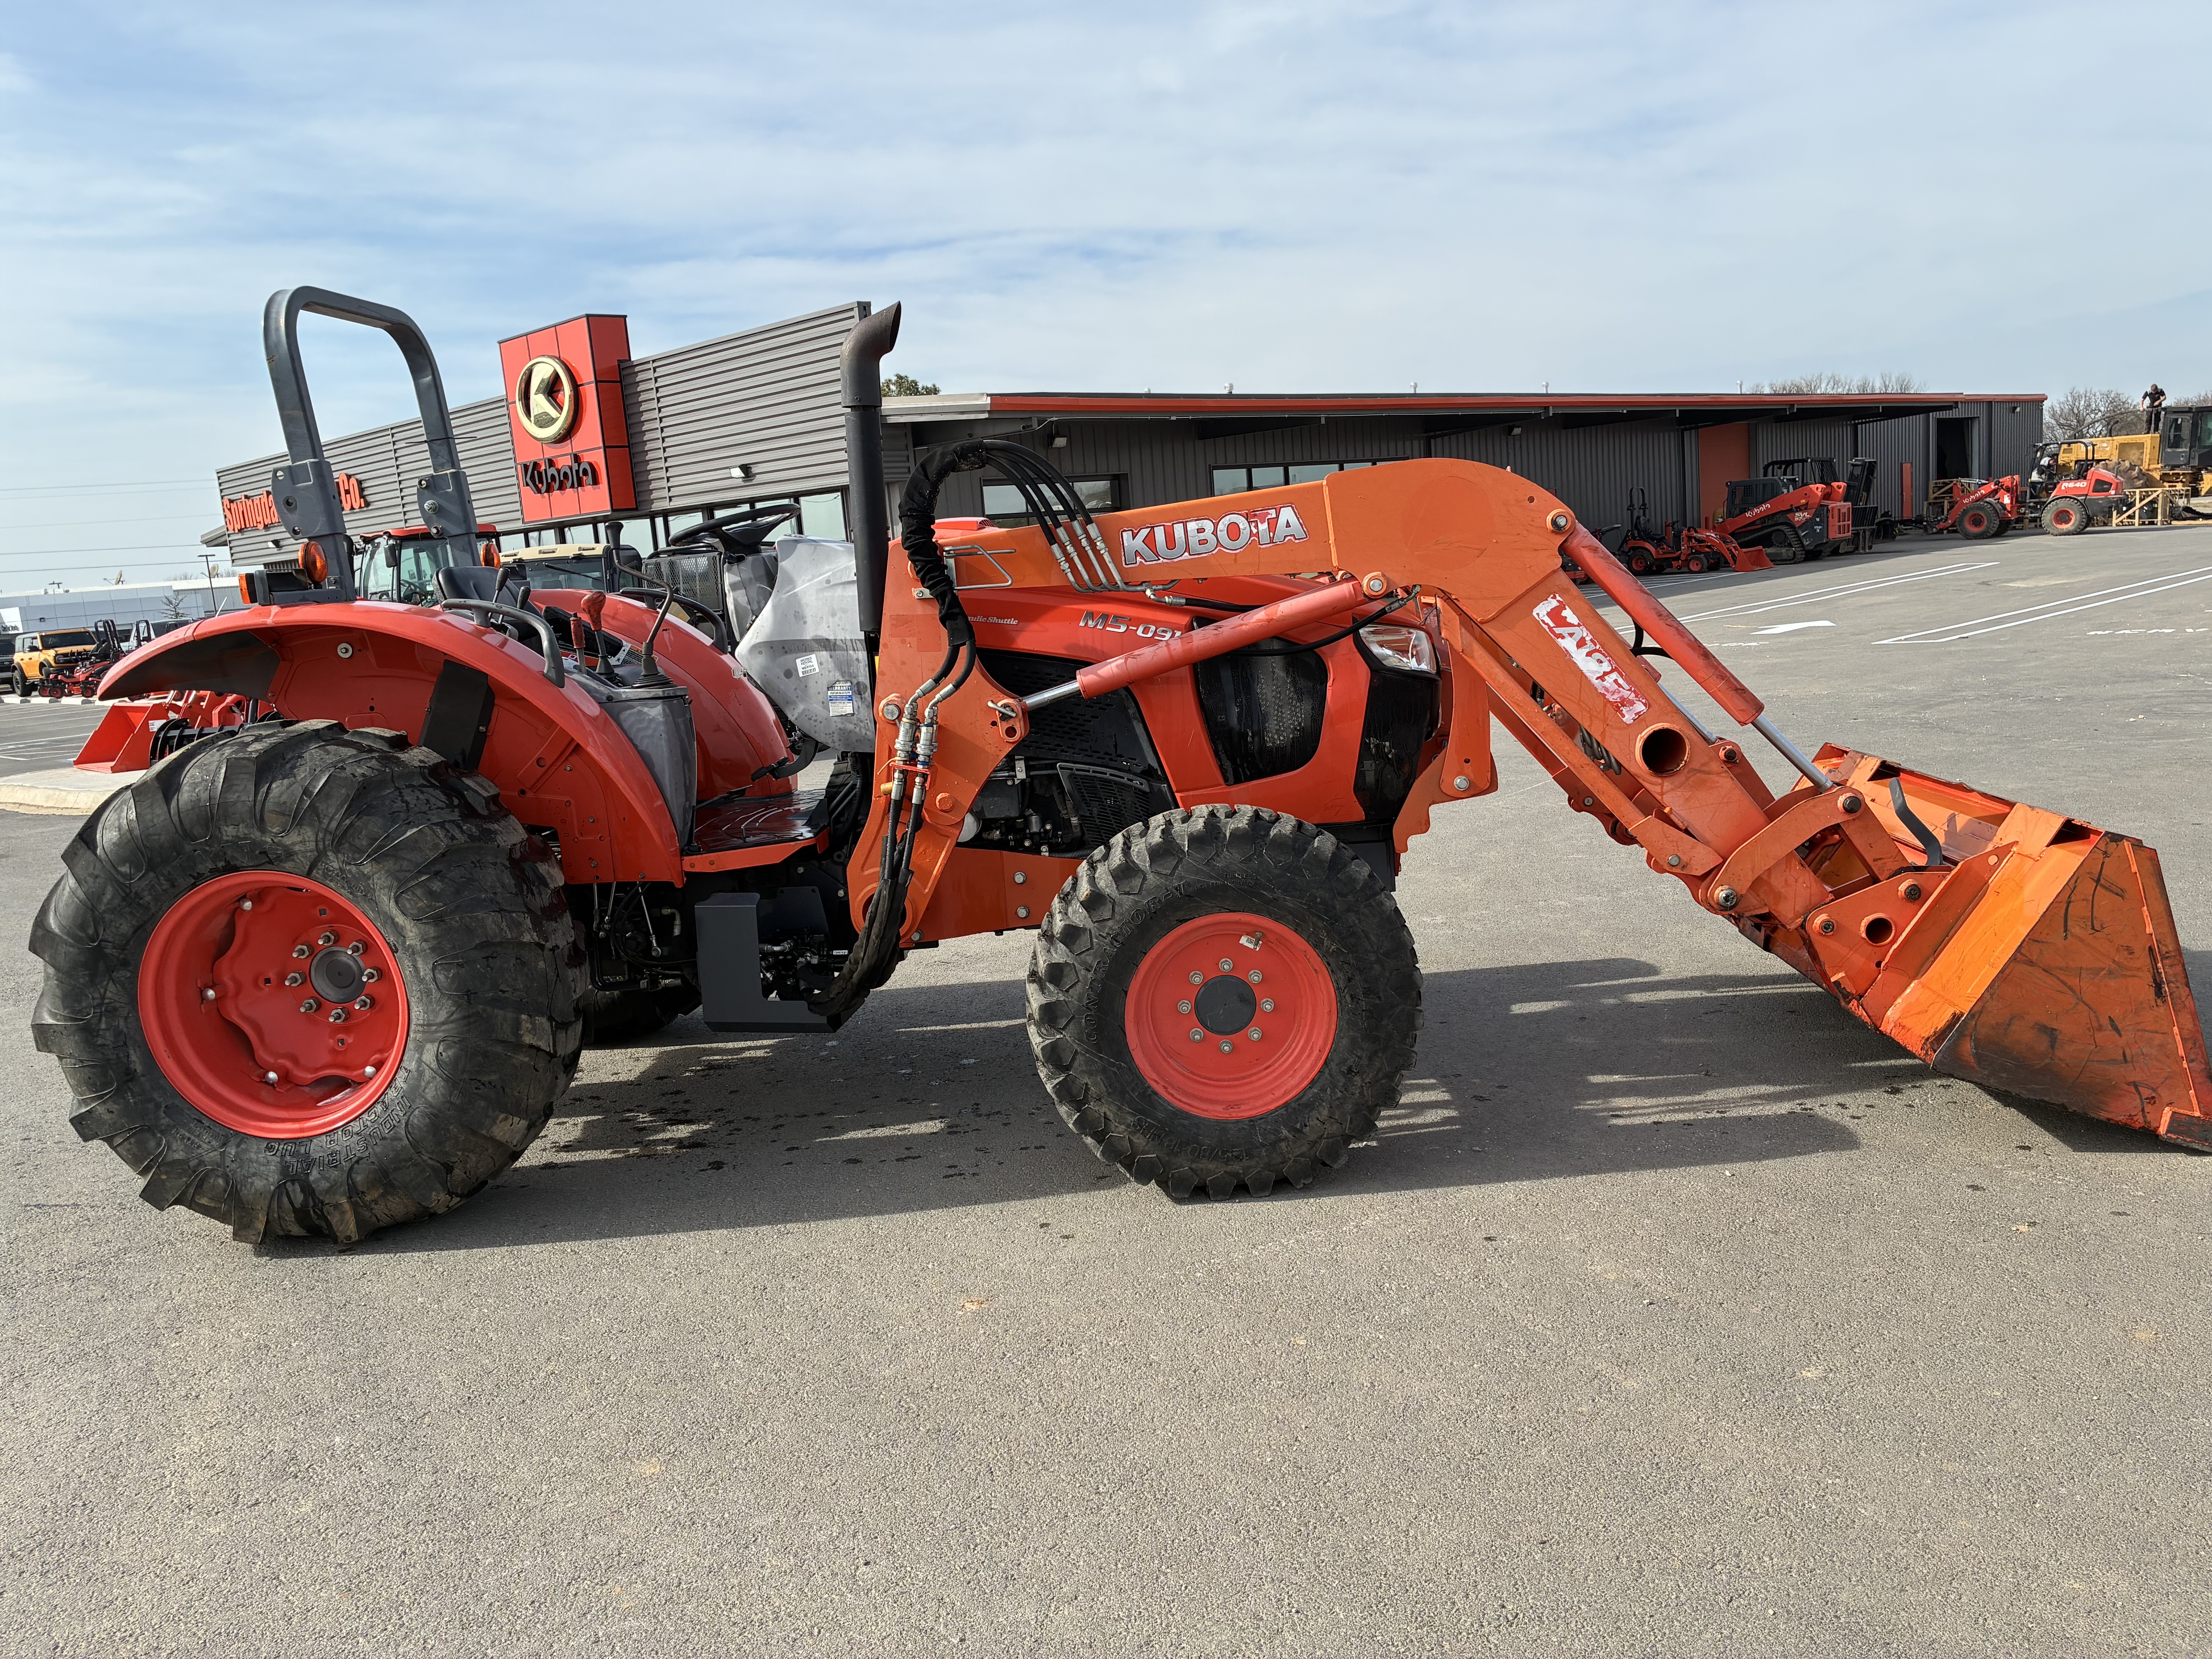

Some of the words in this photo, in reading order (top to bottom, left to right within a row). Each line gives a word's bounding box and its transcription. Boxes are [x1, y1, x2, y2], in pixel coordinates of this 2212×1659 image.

[522, 455, 594, 493] Kubota
[223, 490, 281, 532] Springda
[339, 473, 364, 510] Co.
[1745, 503, 1771, 517] Kubota
[1963, 489, 1985, 503] Kubota
[1121, 506, 1307, 565] KUBOTA
[1079, 610, 1182, 641] M5-091
[326, 1065, 410, 1148] TRACTOR
[264, 1140, 312, 1156] LUG
[285, 1095, 411, 1175] INDUSTRIAL
